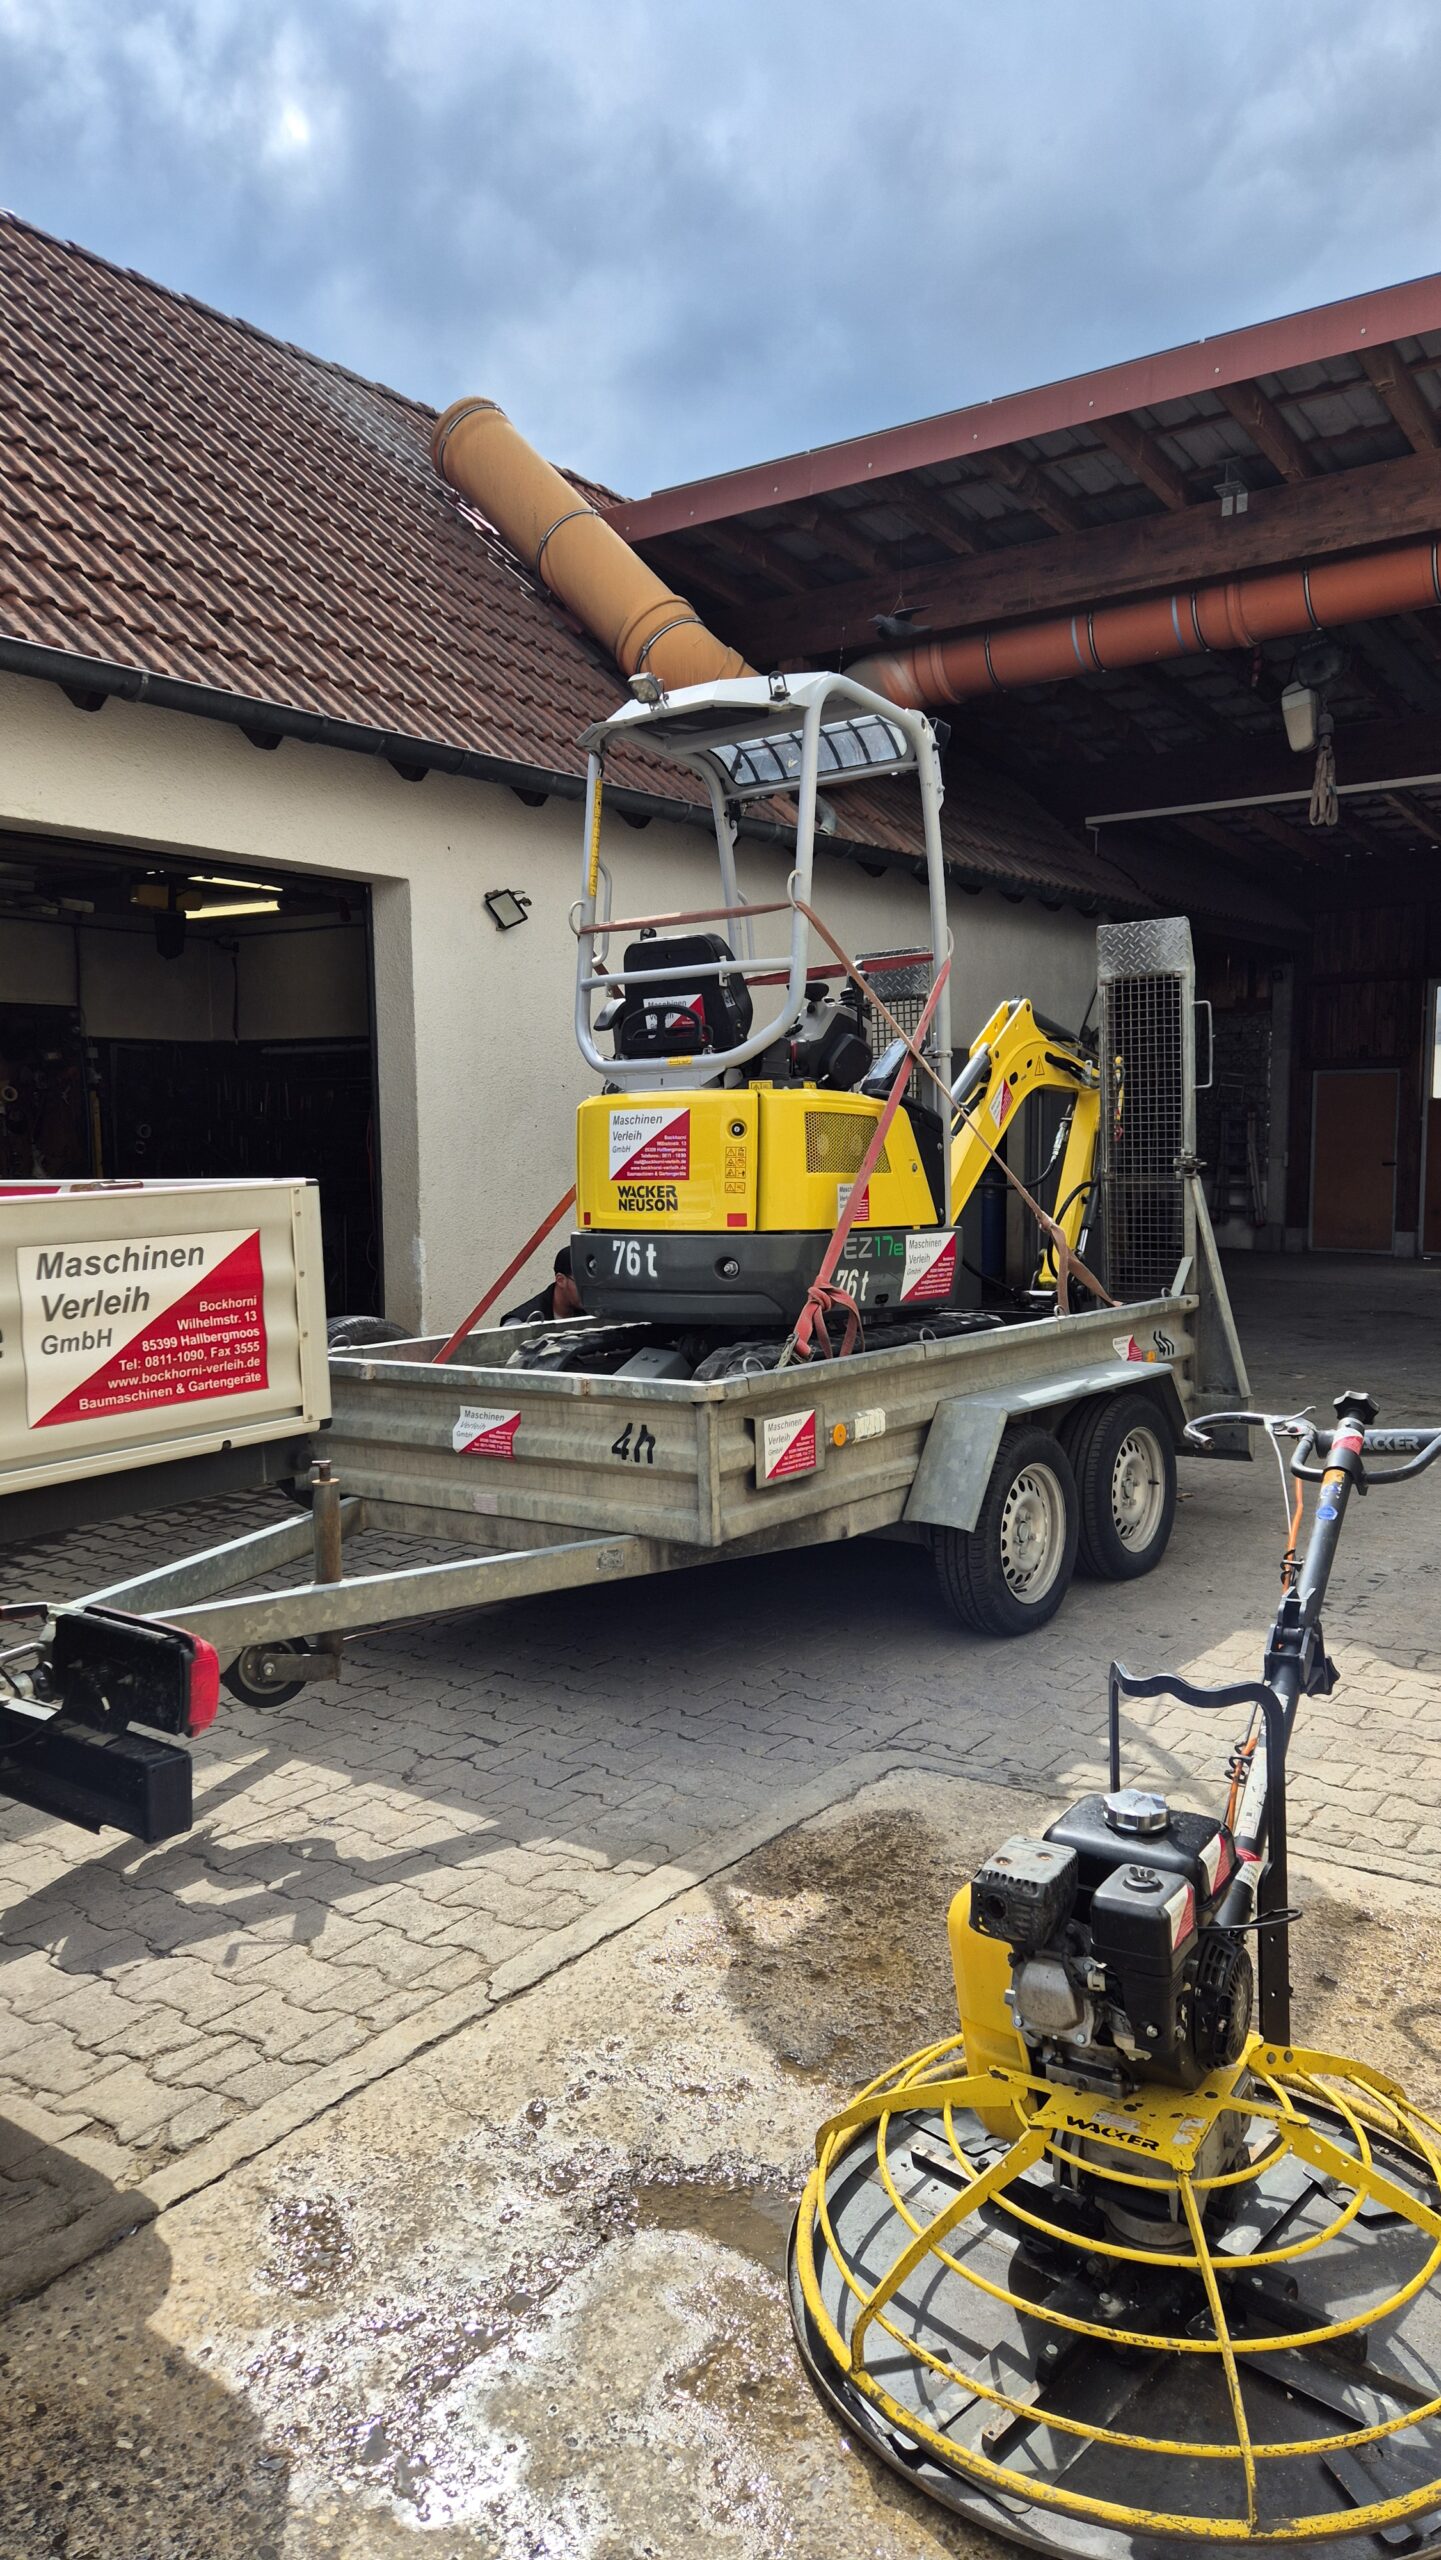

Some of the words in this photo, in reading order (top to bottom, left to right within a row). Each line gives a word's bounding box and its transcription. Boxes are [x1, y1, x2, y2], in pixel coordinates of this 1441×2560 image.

[612, 1114, 663, 1125] Maschinen
[613, 1130, 642, 1141] Verleih
[612, 1145, 631, 1153] GmbH
[617, 1185, 677, 1198] WACKER
[618, 1199, 678, 1211] NEUSON
[908, 1239, 942, 1249] Maschinen
[36, 1245, 204, 1280] Maschinen
[909, 1254, 930, 1264] Verleih
[41, 1286, 150, 1322] Verleih
[200, 1296, 257, 1312] Bockhorni
[177, 1315, 241, 1331] Wilhelmstr.
[244, 1311, 257, 1322] 13
[41, 1328, 112, 1355] GmbH
[142, 1336, 178, 1352] 85399
[180, 1328, 260, 1347] Hallbergmoos
[119, 1360, 141, 1371] Tel:
[145, 1349, 207, 1368] 0811-1090,
[210, 1346, 231, 1358] Fax
[234, 1341, 260, 1355] 3555
[108, 1357, 260, 1389] www.bockhorni-verleih.de
[79, 1387, 173, 1411] Baumaschinen
[176, 1383, 185, 1394] &
[188, 1372, 261, 1391] Gartengeräte
[464, 1410, 504, 1421] Maschinen
[460, 1421, 486, 1430] Verleih
[768, 1418, 802, 1431] Maschinen
[768, 1433, 790, 1445] Verleih
[1363, 1435, 1420, 1451] ACKER
[1066, 2115, 1160, 2151] WACKER
